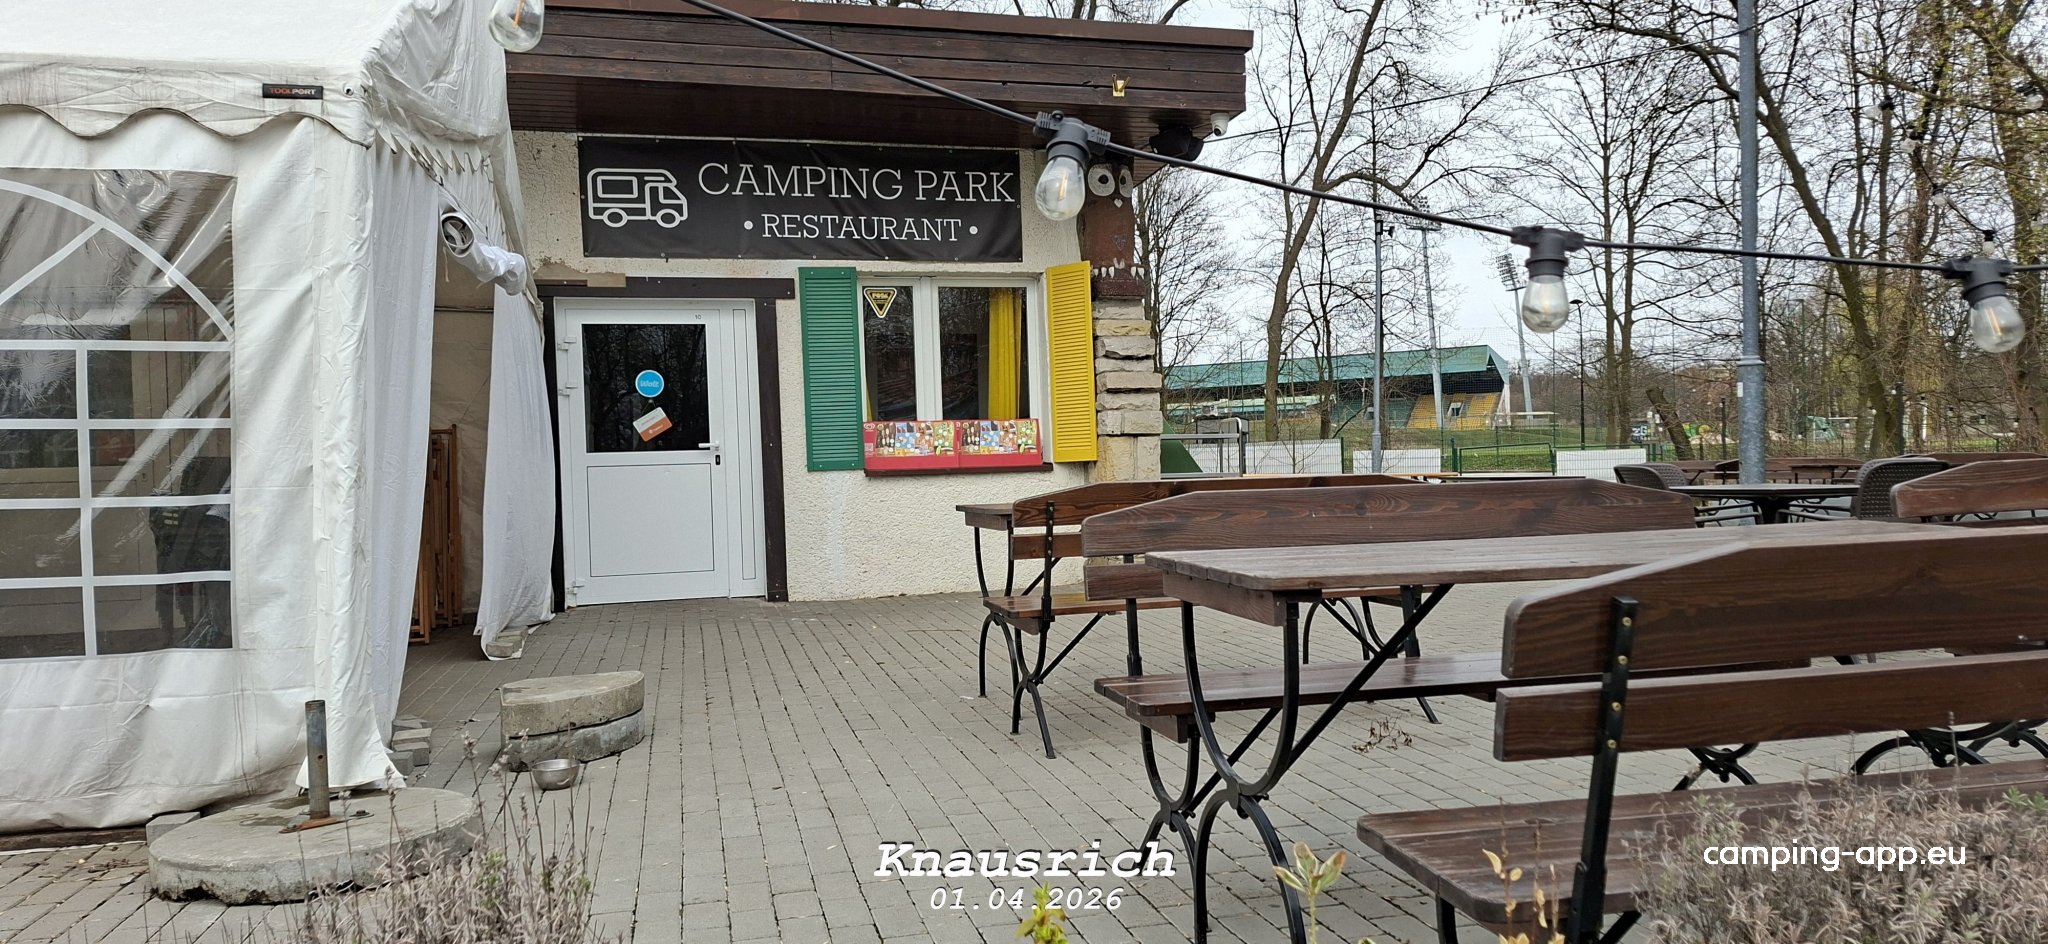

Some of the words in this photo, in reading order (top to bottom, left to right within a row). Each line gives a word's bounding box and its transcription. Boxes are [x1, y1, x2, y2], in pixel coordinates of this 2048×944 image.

[270, 87, 316, 95] TOOLPORT
[698, 162, 903, 201] CAMPING
[914, 169, 1016, 203] PARK
[761, 213, 962, 242] RESTAURANT
